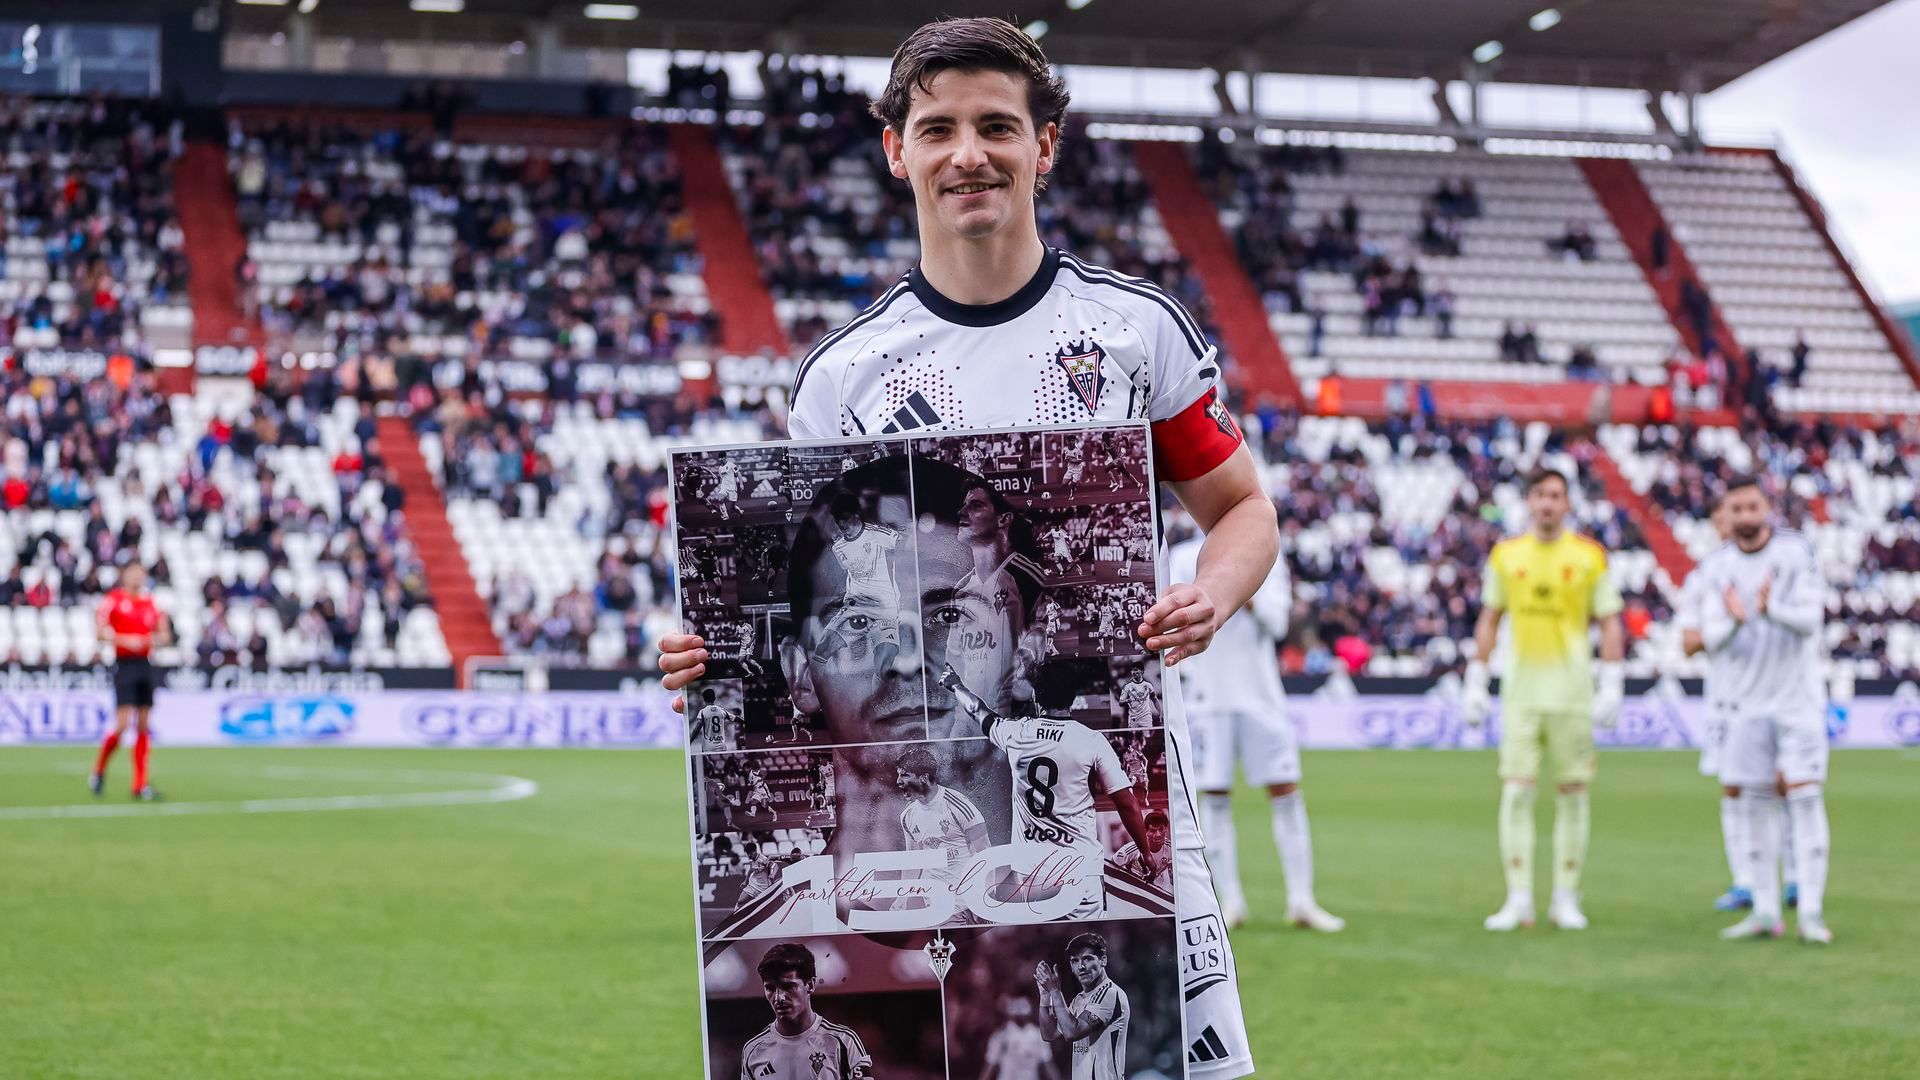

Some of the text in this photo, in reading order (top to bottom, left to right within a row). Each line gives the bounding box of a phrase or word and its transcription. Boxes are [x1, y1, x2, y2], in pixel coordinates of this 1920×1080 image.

[1098, 546, 1124, 561] VISTO
[1128, 603, 1142, 617] 20
[711, 715, 721, 733] 8
[1036, 728, 1064, 742] RIKI
[1025, 756, 1059, 818] 8
[779, 849, 1087, 925] partidos con el Alba
[782, 843, 1086, 932] 150
[1183, 924, 1218, 947] UA
